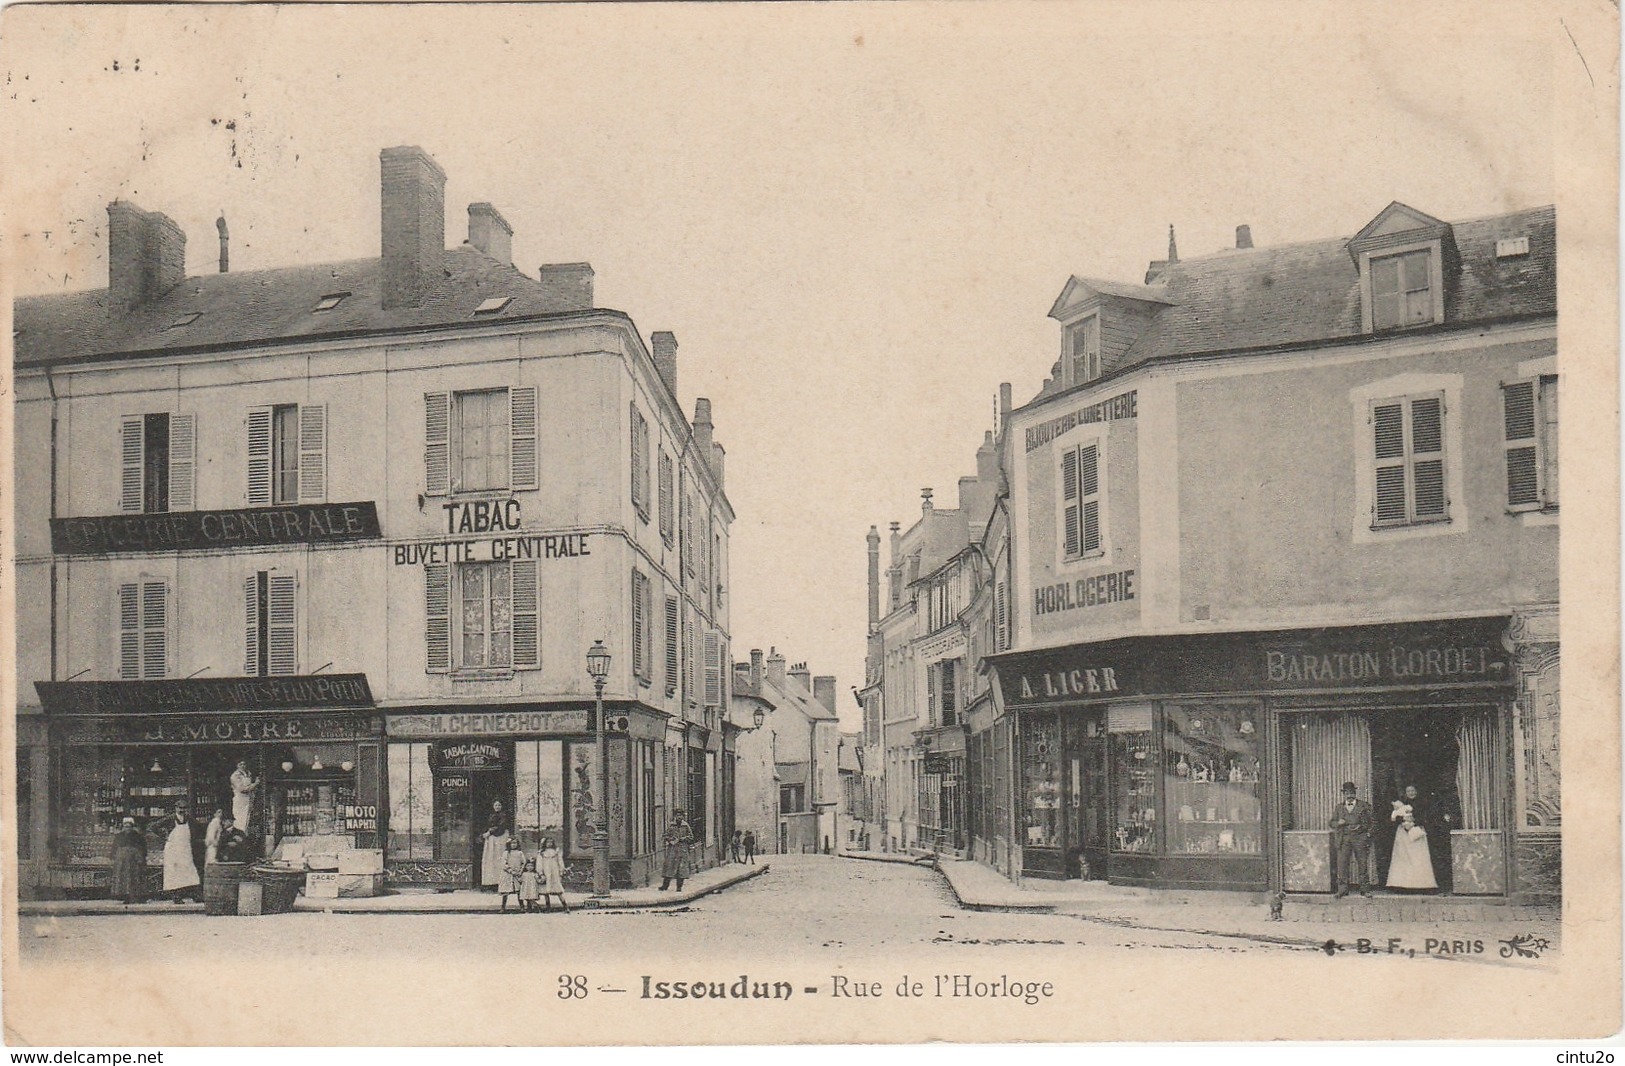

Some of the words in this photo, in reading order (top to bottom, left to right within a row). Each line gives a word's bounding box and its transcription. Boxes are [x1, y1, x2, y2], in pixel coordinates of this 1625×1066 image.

[1025, 412, 1077, 454] BIJOUTERIE
[1077, 389, 1138, 425] LUNETTERIE
[200, 507, 365, 541] CENTRALE
[442, 499, 521, 534] TABAC
[394, 540, 477, 566] BUVETTE
[491, 533, 591, 560] CENTRALE
[1035, 569, 1135, 615] HORLOGERIE
[1266, 651, 1381, 682] BARATON
[317, 678, 366, 701] POTIN
[1022, 676, 1038, 698] A.
[1044, 667, 1119, 697] LIGER
[182, 719, 303, 740] MOTRE
[449, 713, 552, 734] CHENECHOT
[442, 744, 468, 759] TABAC
[441, 777, 468, 787] PUNCH
[345, 805, 376, 818] MOTO
